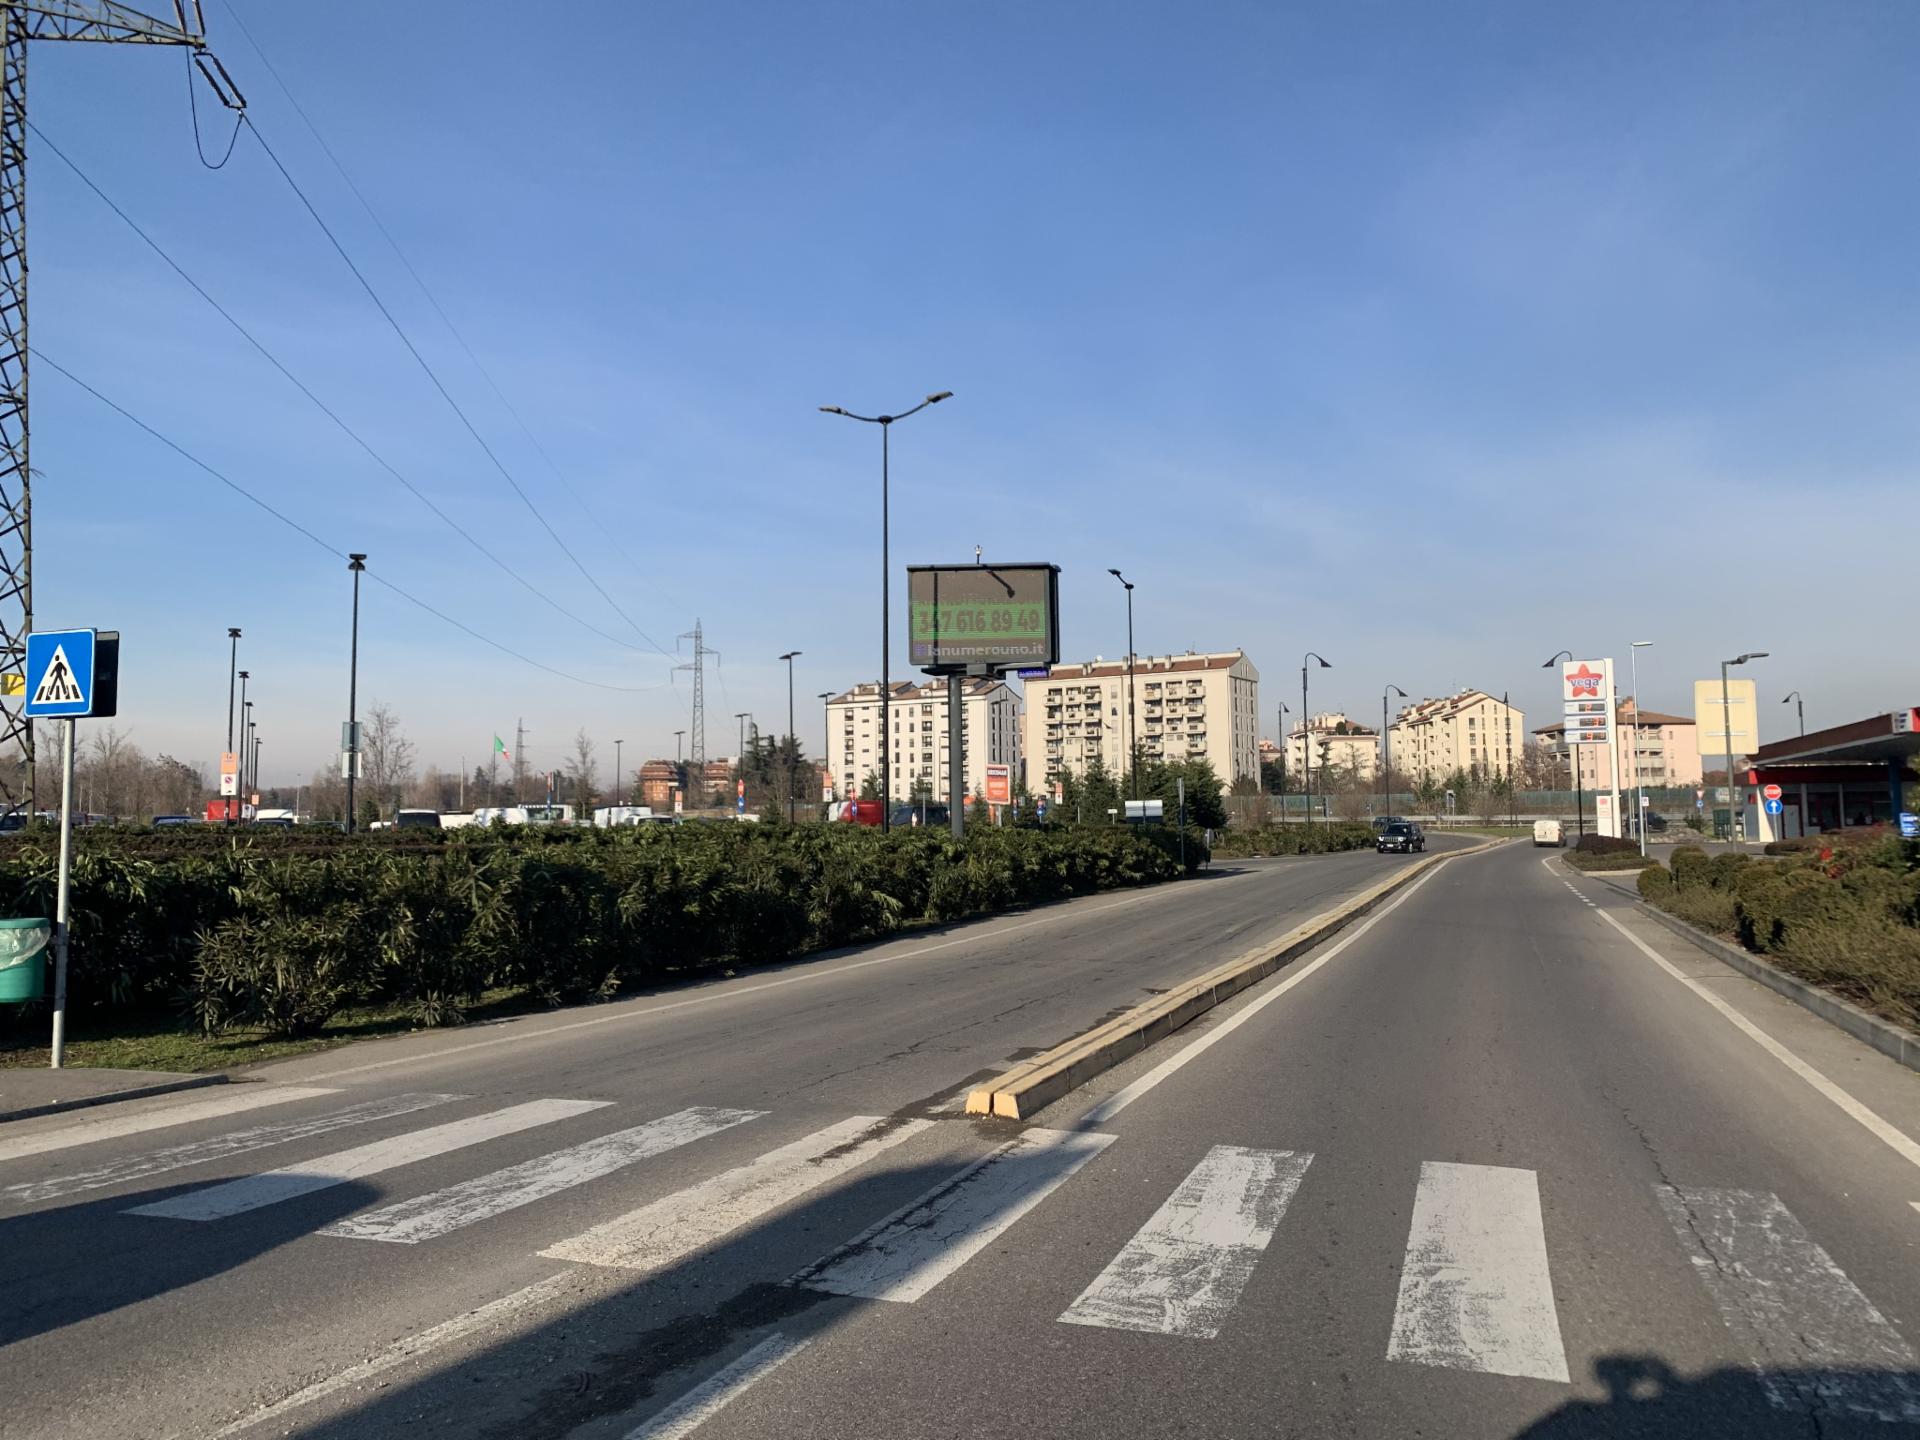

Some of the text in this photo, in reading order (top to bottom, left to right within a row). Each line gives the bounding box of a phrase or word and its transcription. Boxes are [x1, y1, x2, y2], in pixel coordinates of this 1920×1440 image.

[955, 609, 985, 633] 616
[991, 608, 1013, 633] 89
[1017, 608, 1040, 633] 49
[1570, 678, 1600, 688] vega
